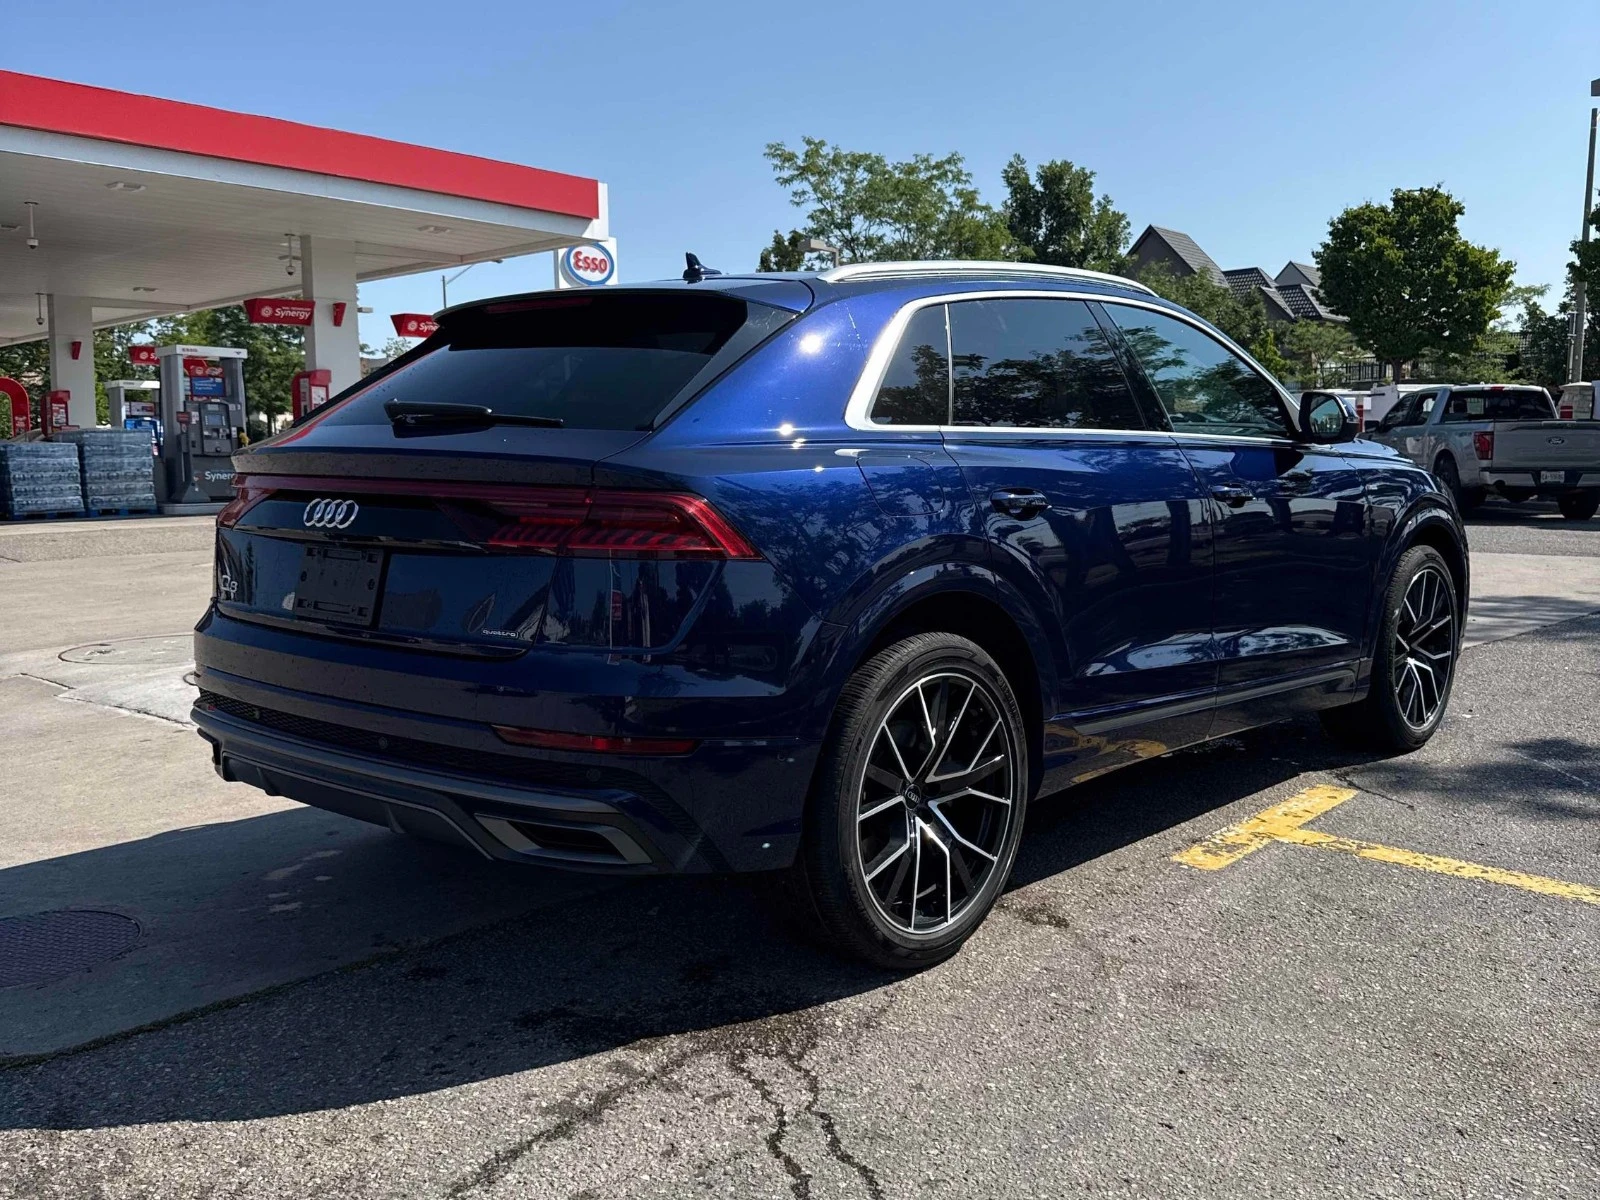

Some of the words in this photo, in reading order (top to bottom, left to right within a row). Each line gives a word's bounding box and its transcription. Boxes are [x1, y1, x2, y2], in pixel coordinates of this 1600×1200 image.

[573, 251, 607, 274] Esso
[274, 307, 311, 320] Synergy
[205, 471, 235, 482] Syner
[221, 574, 238, 593] Q8
[482, 629, 517, 638] quattro
